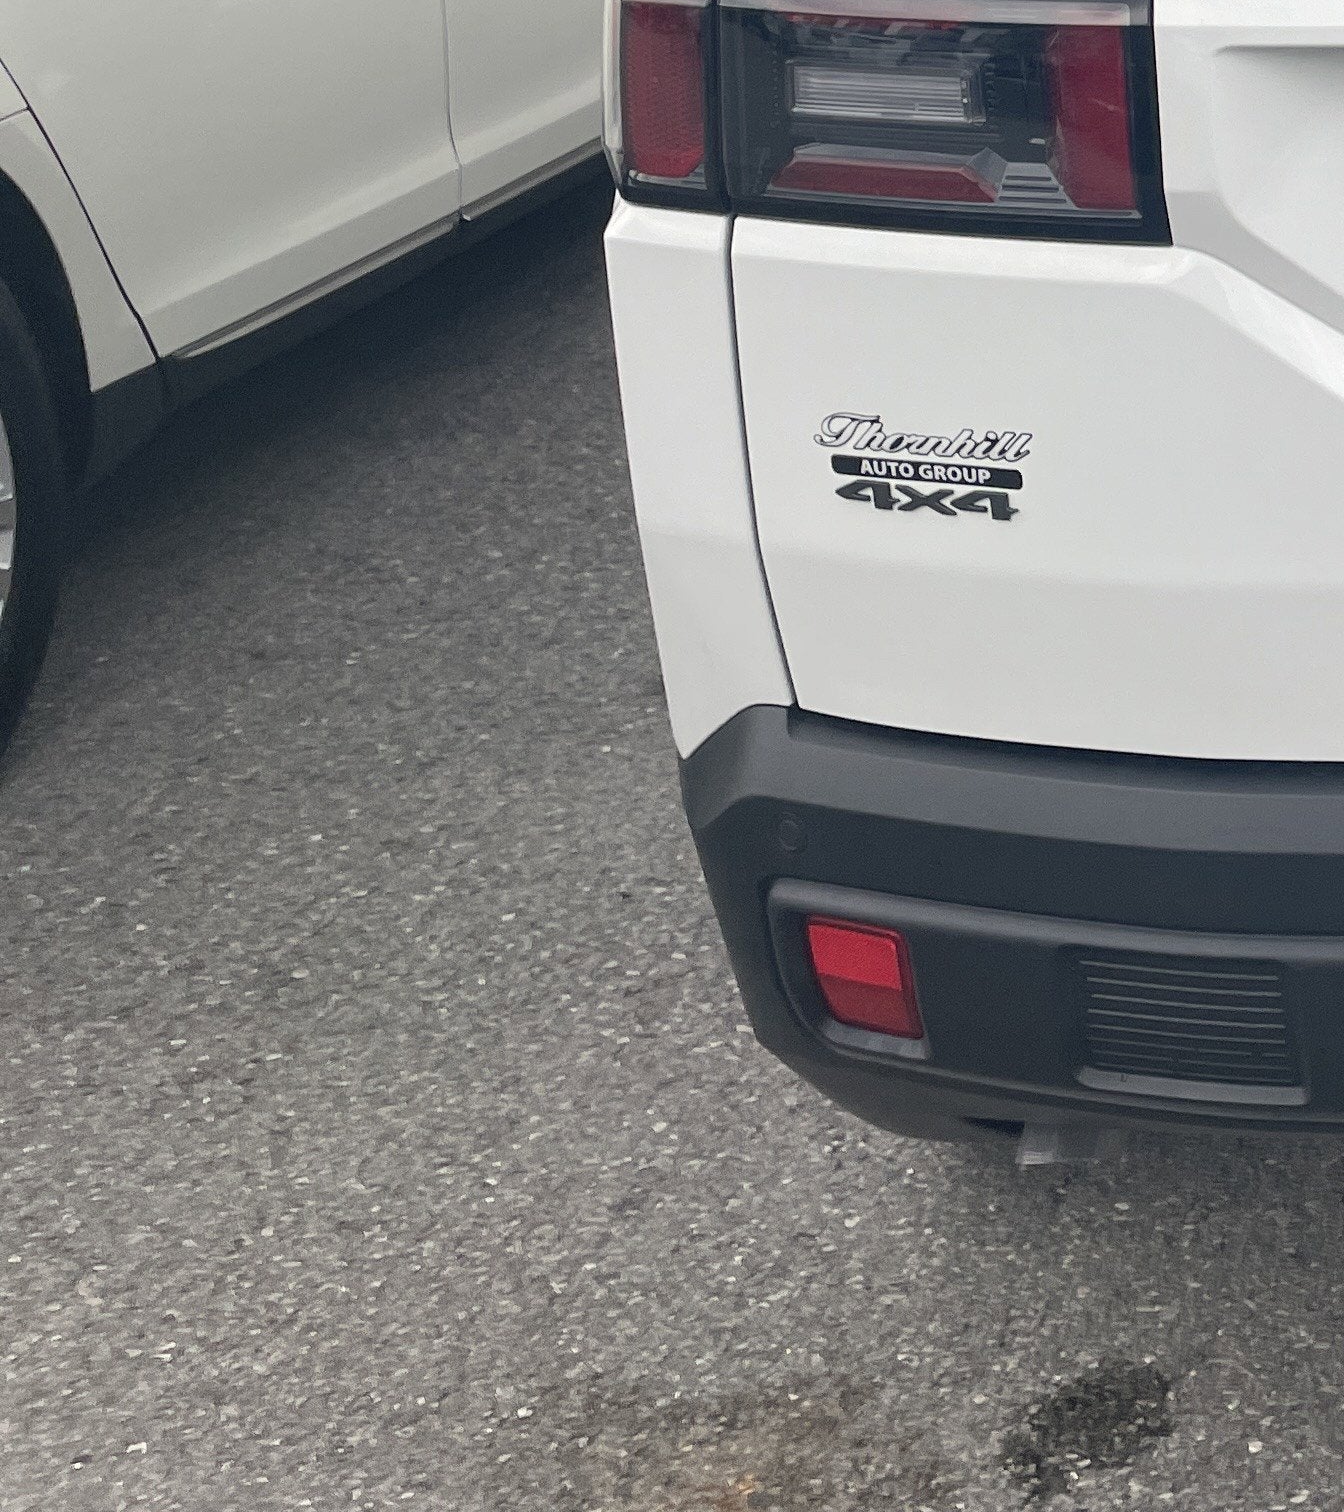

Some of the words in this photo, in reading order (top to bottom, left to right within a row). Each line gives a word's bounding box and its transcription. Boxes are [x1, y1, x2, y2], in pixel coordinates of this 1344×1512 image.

[813, 412, 1033, 462] Thornhill
[860, 459, 914, 479] AUTO
[918, 464, 991, 484] GROUP
